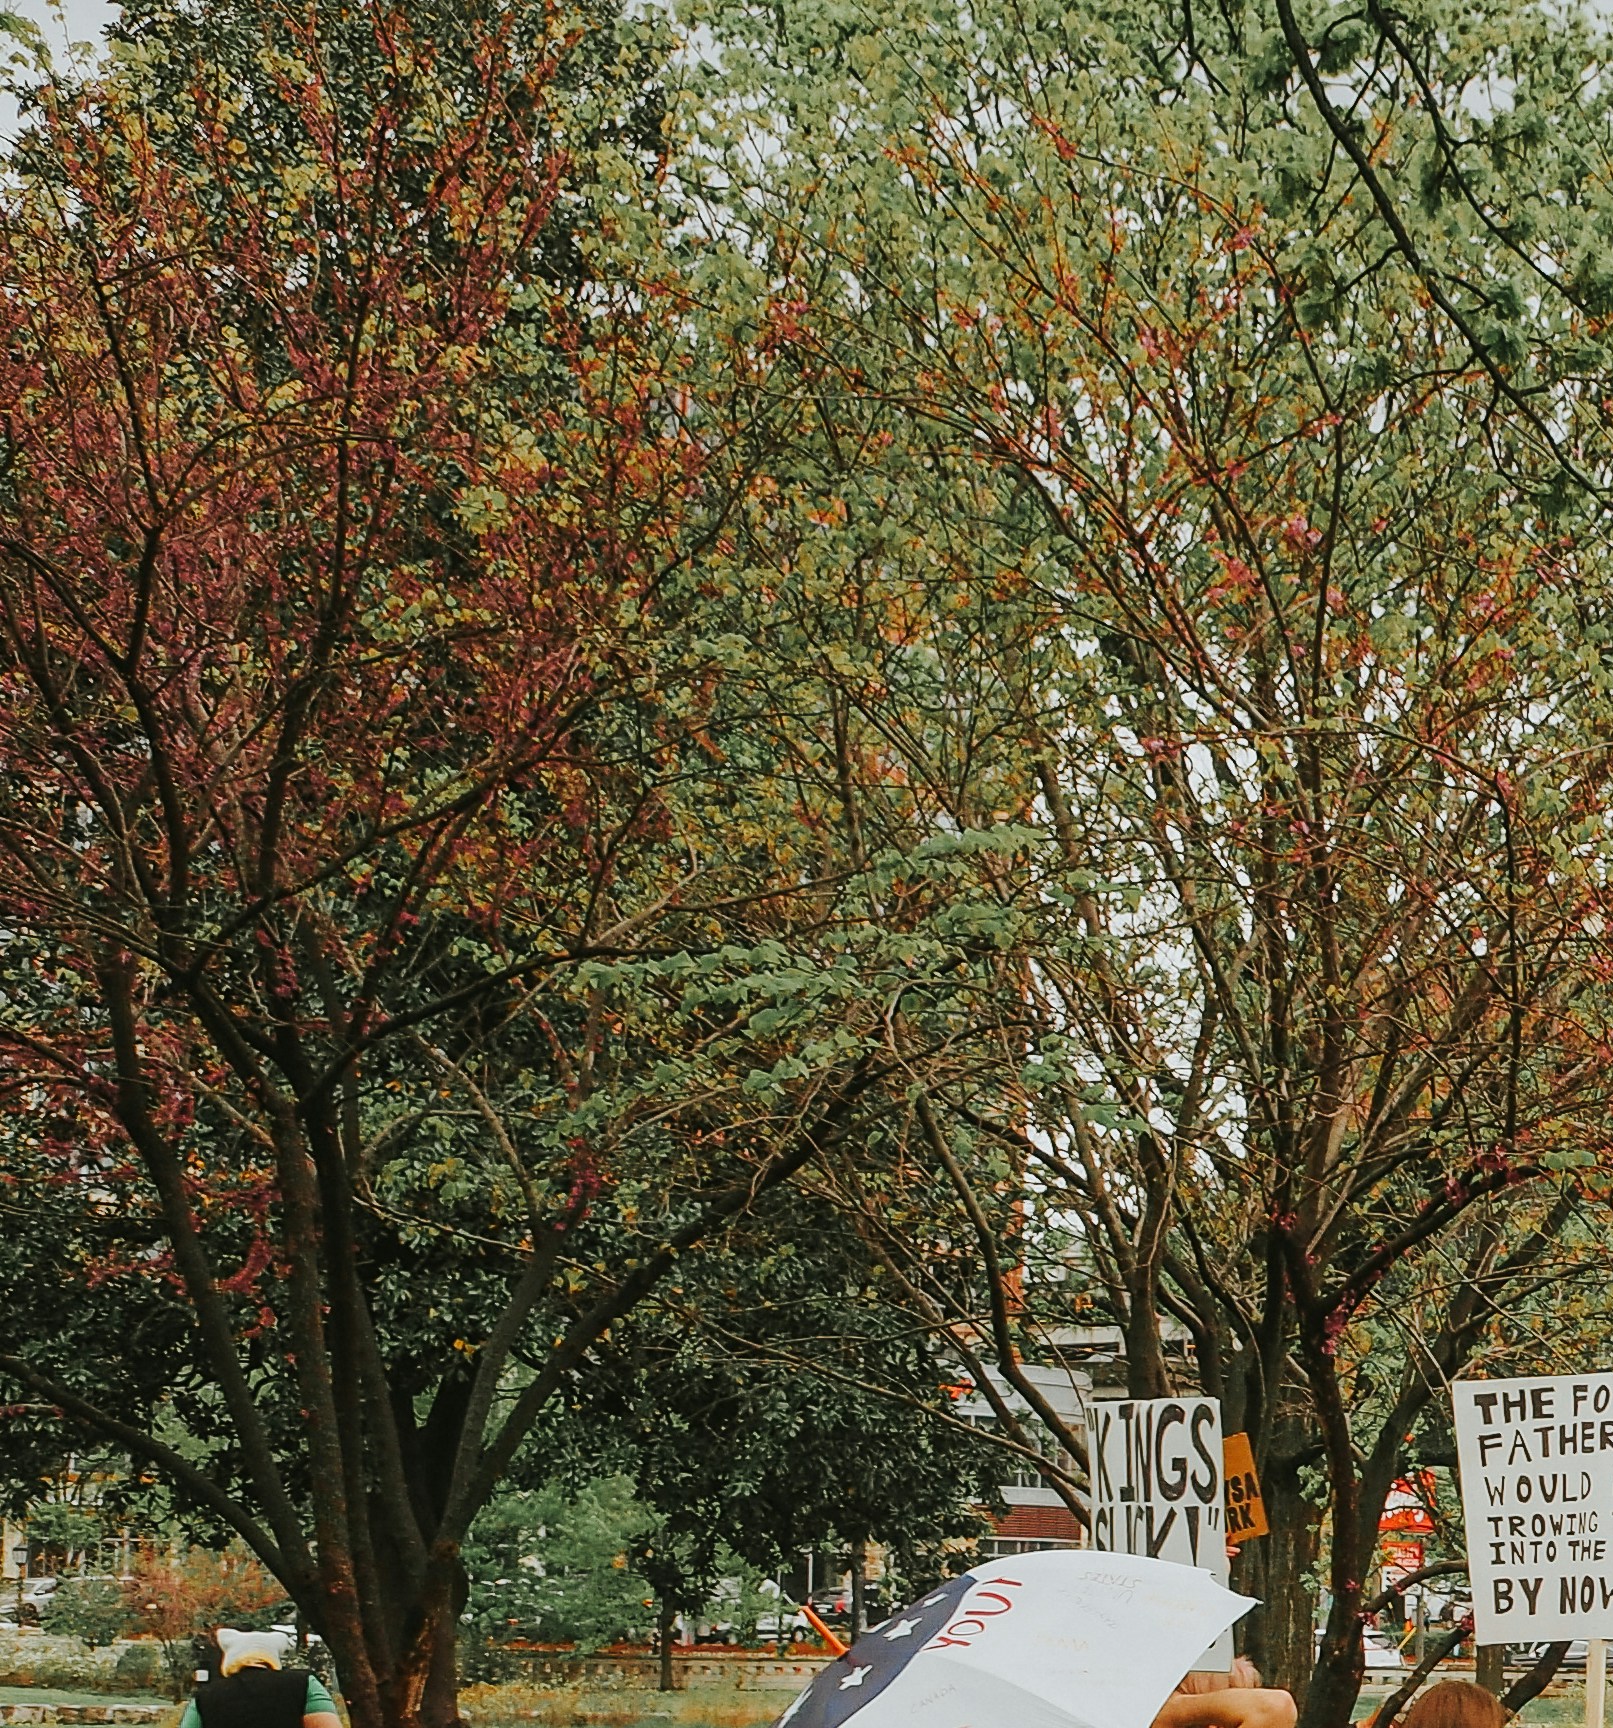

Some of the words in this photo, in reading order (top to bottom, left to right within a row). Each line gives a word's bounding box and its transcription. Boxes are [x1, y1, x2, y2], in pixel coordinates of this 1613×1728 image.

[1474, 1386, 1555, 1425] THE
[1484, 1471, 1592, 1507] WOULD
[1224, 1503, 1256, 1534] RK
[1487, 1511, 1599, 1538] TROWING
[1489, 1540, 1557, 1565] INTO
[1568, 1540, 1607, 1562] THE
[1492, 1577, 1544, 1615] BY
